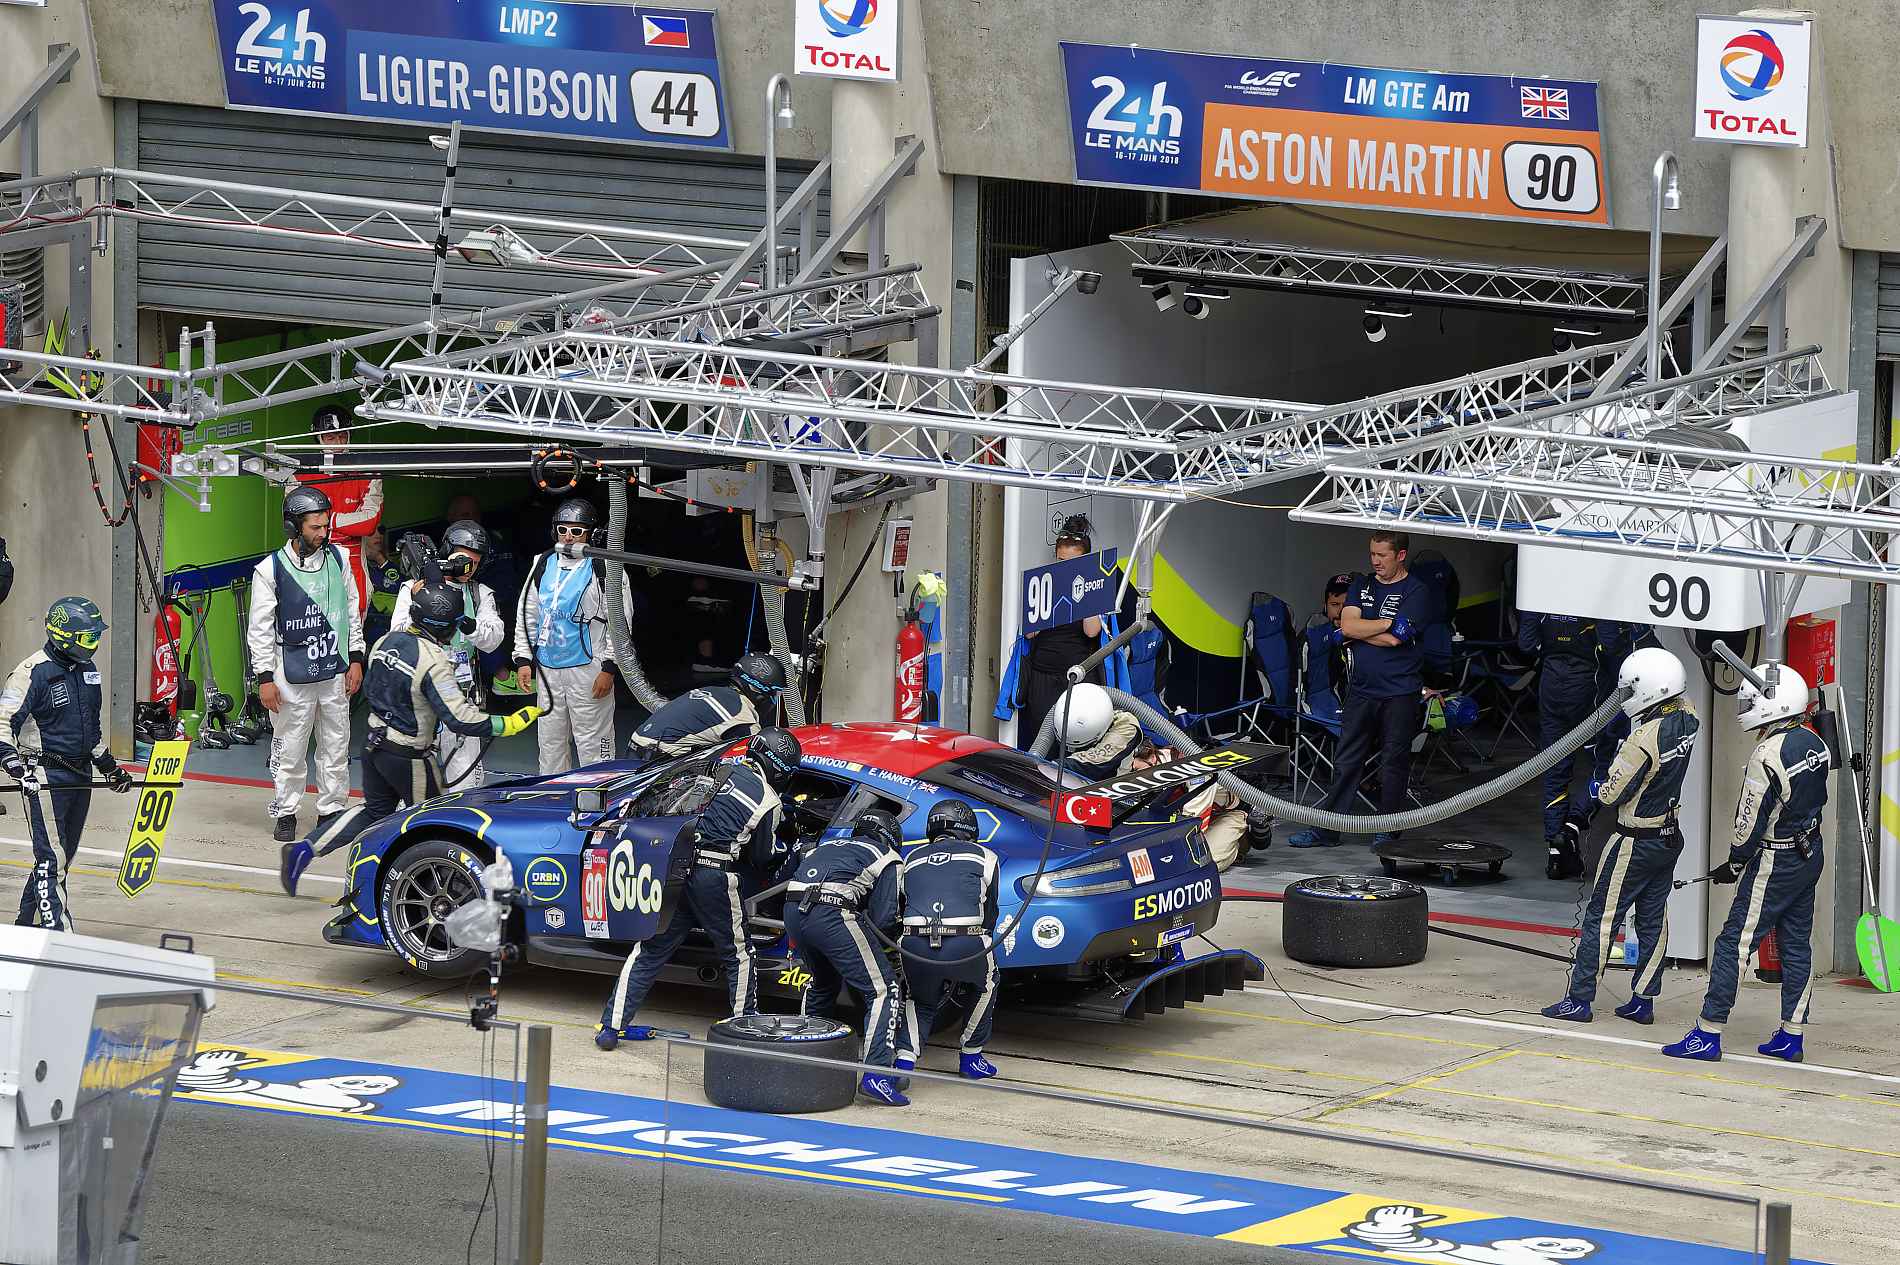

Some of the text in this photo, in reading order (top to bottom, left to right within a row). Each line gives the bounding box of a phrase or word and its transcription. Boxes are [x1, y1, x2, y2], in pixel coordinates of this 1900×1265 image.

[236, 2, 326, 63] 24h
[500, 6, 557, 37] LMP2
[235, 57, 326, 80] LE MANS
[804, 45, 890, 72] TOTAL
[264, 76, 325, 90] 16-17 JUIN 2018
[359, 53, 617, 123] LIGIER-GIBSON
[1240, 71, 1301, 88] WEC
[1344, 76, 1470, 113] LM GTE Am
[651, 80, 699, 127] 44
[1087, 75, 1183, 137] 24h
[1703, 109, 1796, 136] TOTAL
[1084, 131, 1180, 155] LE MANS
[1115, 151, 1179, 165] 16-17 JUIN 2018
[1214, 127, 1491, 200] ASTON MARTIN
[1527, 153, 1577, 202] 90
[1028, 572, 1054, 624] 90
[1084, 578, 1105, 593] SPORT
[1648, 572, 1711, 622] 90
[286, 615, 322, 631] PITLANE
[153, 757, 181, 776] STOP
[879, 769, 917, 788] HANKEY
[137, 790, 174, 833] 90
[129, 856, 153, 879] TF
[1131, 853, 1153, 879] AM
[37, 859, 56, 928] TF SPORT
[585, 872, 604, 919] 90
[1134, 878, 1213, 921] ESMOTOR
[548, 913, 562, 923] TF
[885, 997, 899, 1050] SPORT
[405, 1099, 1255, 1216] MICHELIN
